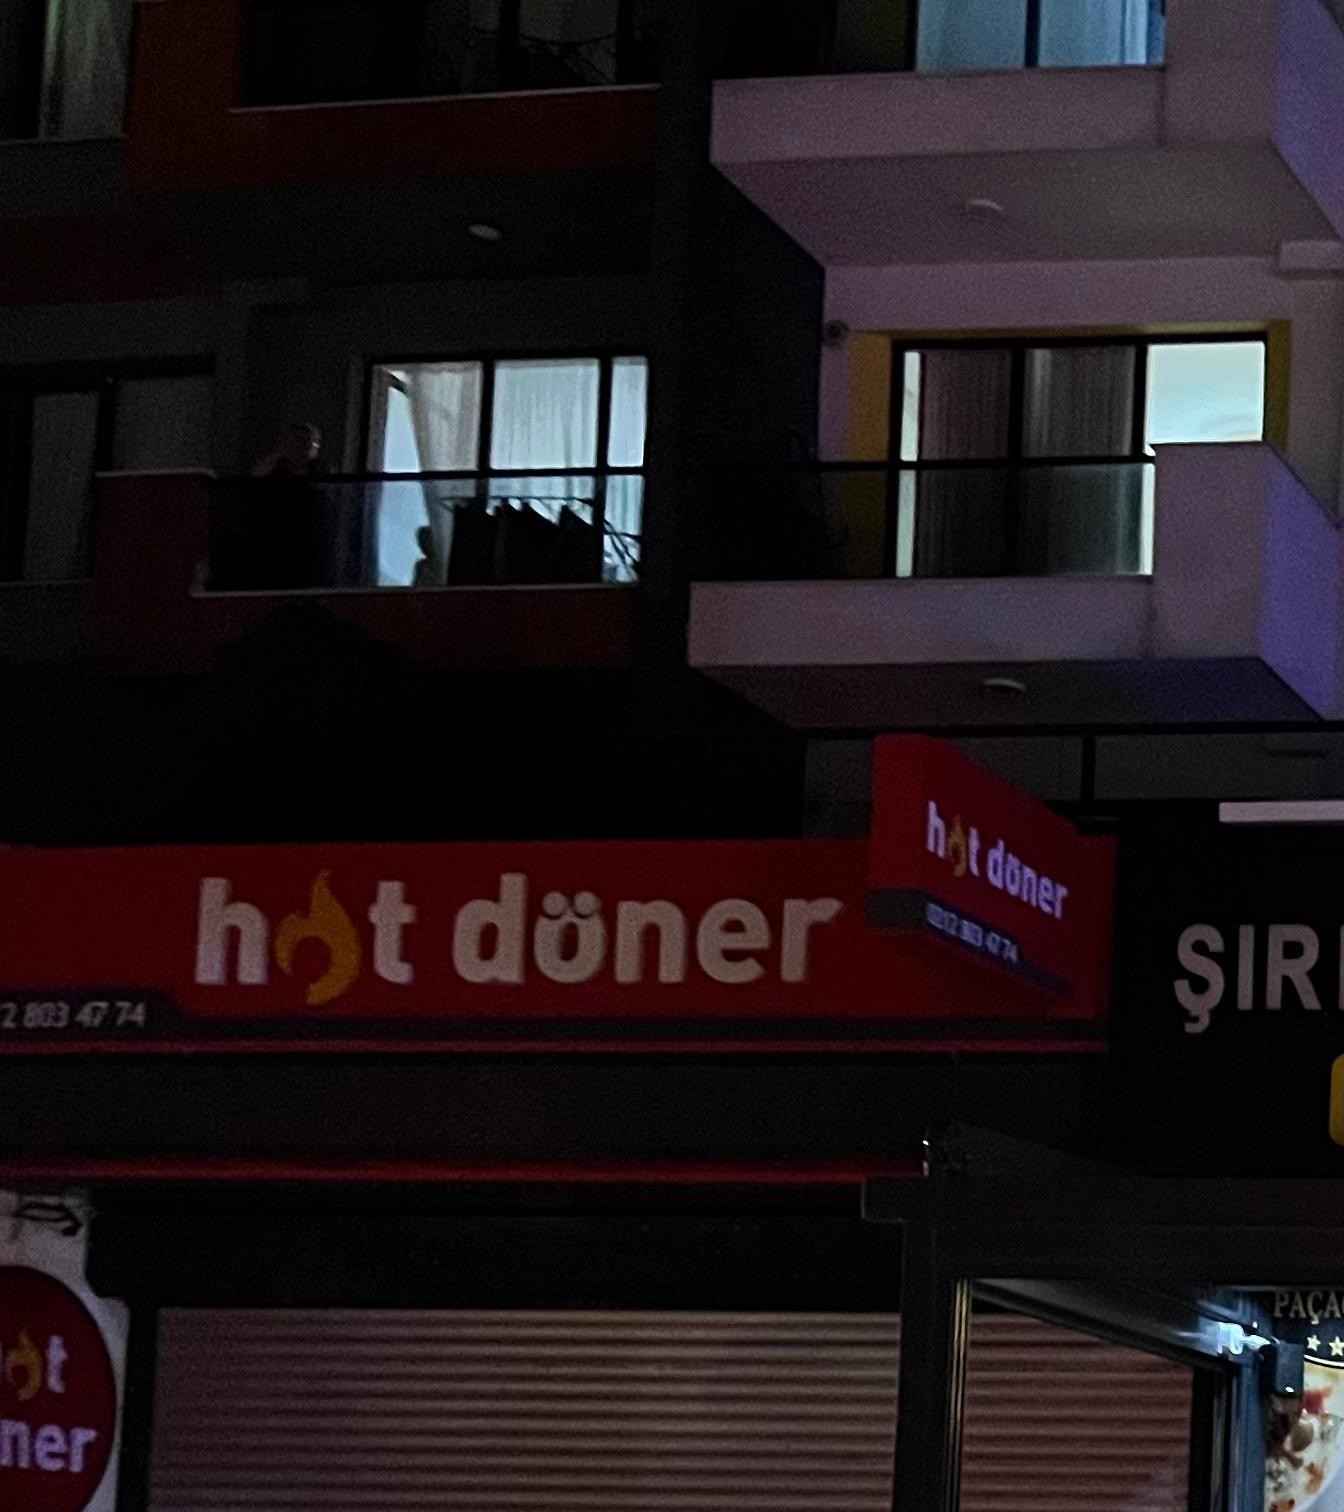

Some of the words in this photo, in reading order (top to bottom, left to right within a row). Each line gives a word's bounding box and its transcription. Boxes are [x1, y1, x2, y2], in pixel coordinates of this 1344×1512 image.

[194, 869, 417, 1006] hot
[452, 872, 843, 985] döner
[73, 1000, 110, 1028] 47
[114, 1000, 147, 1028] 74
[0, 1328, 68, 1401] ot
